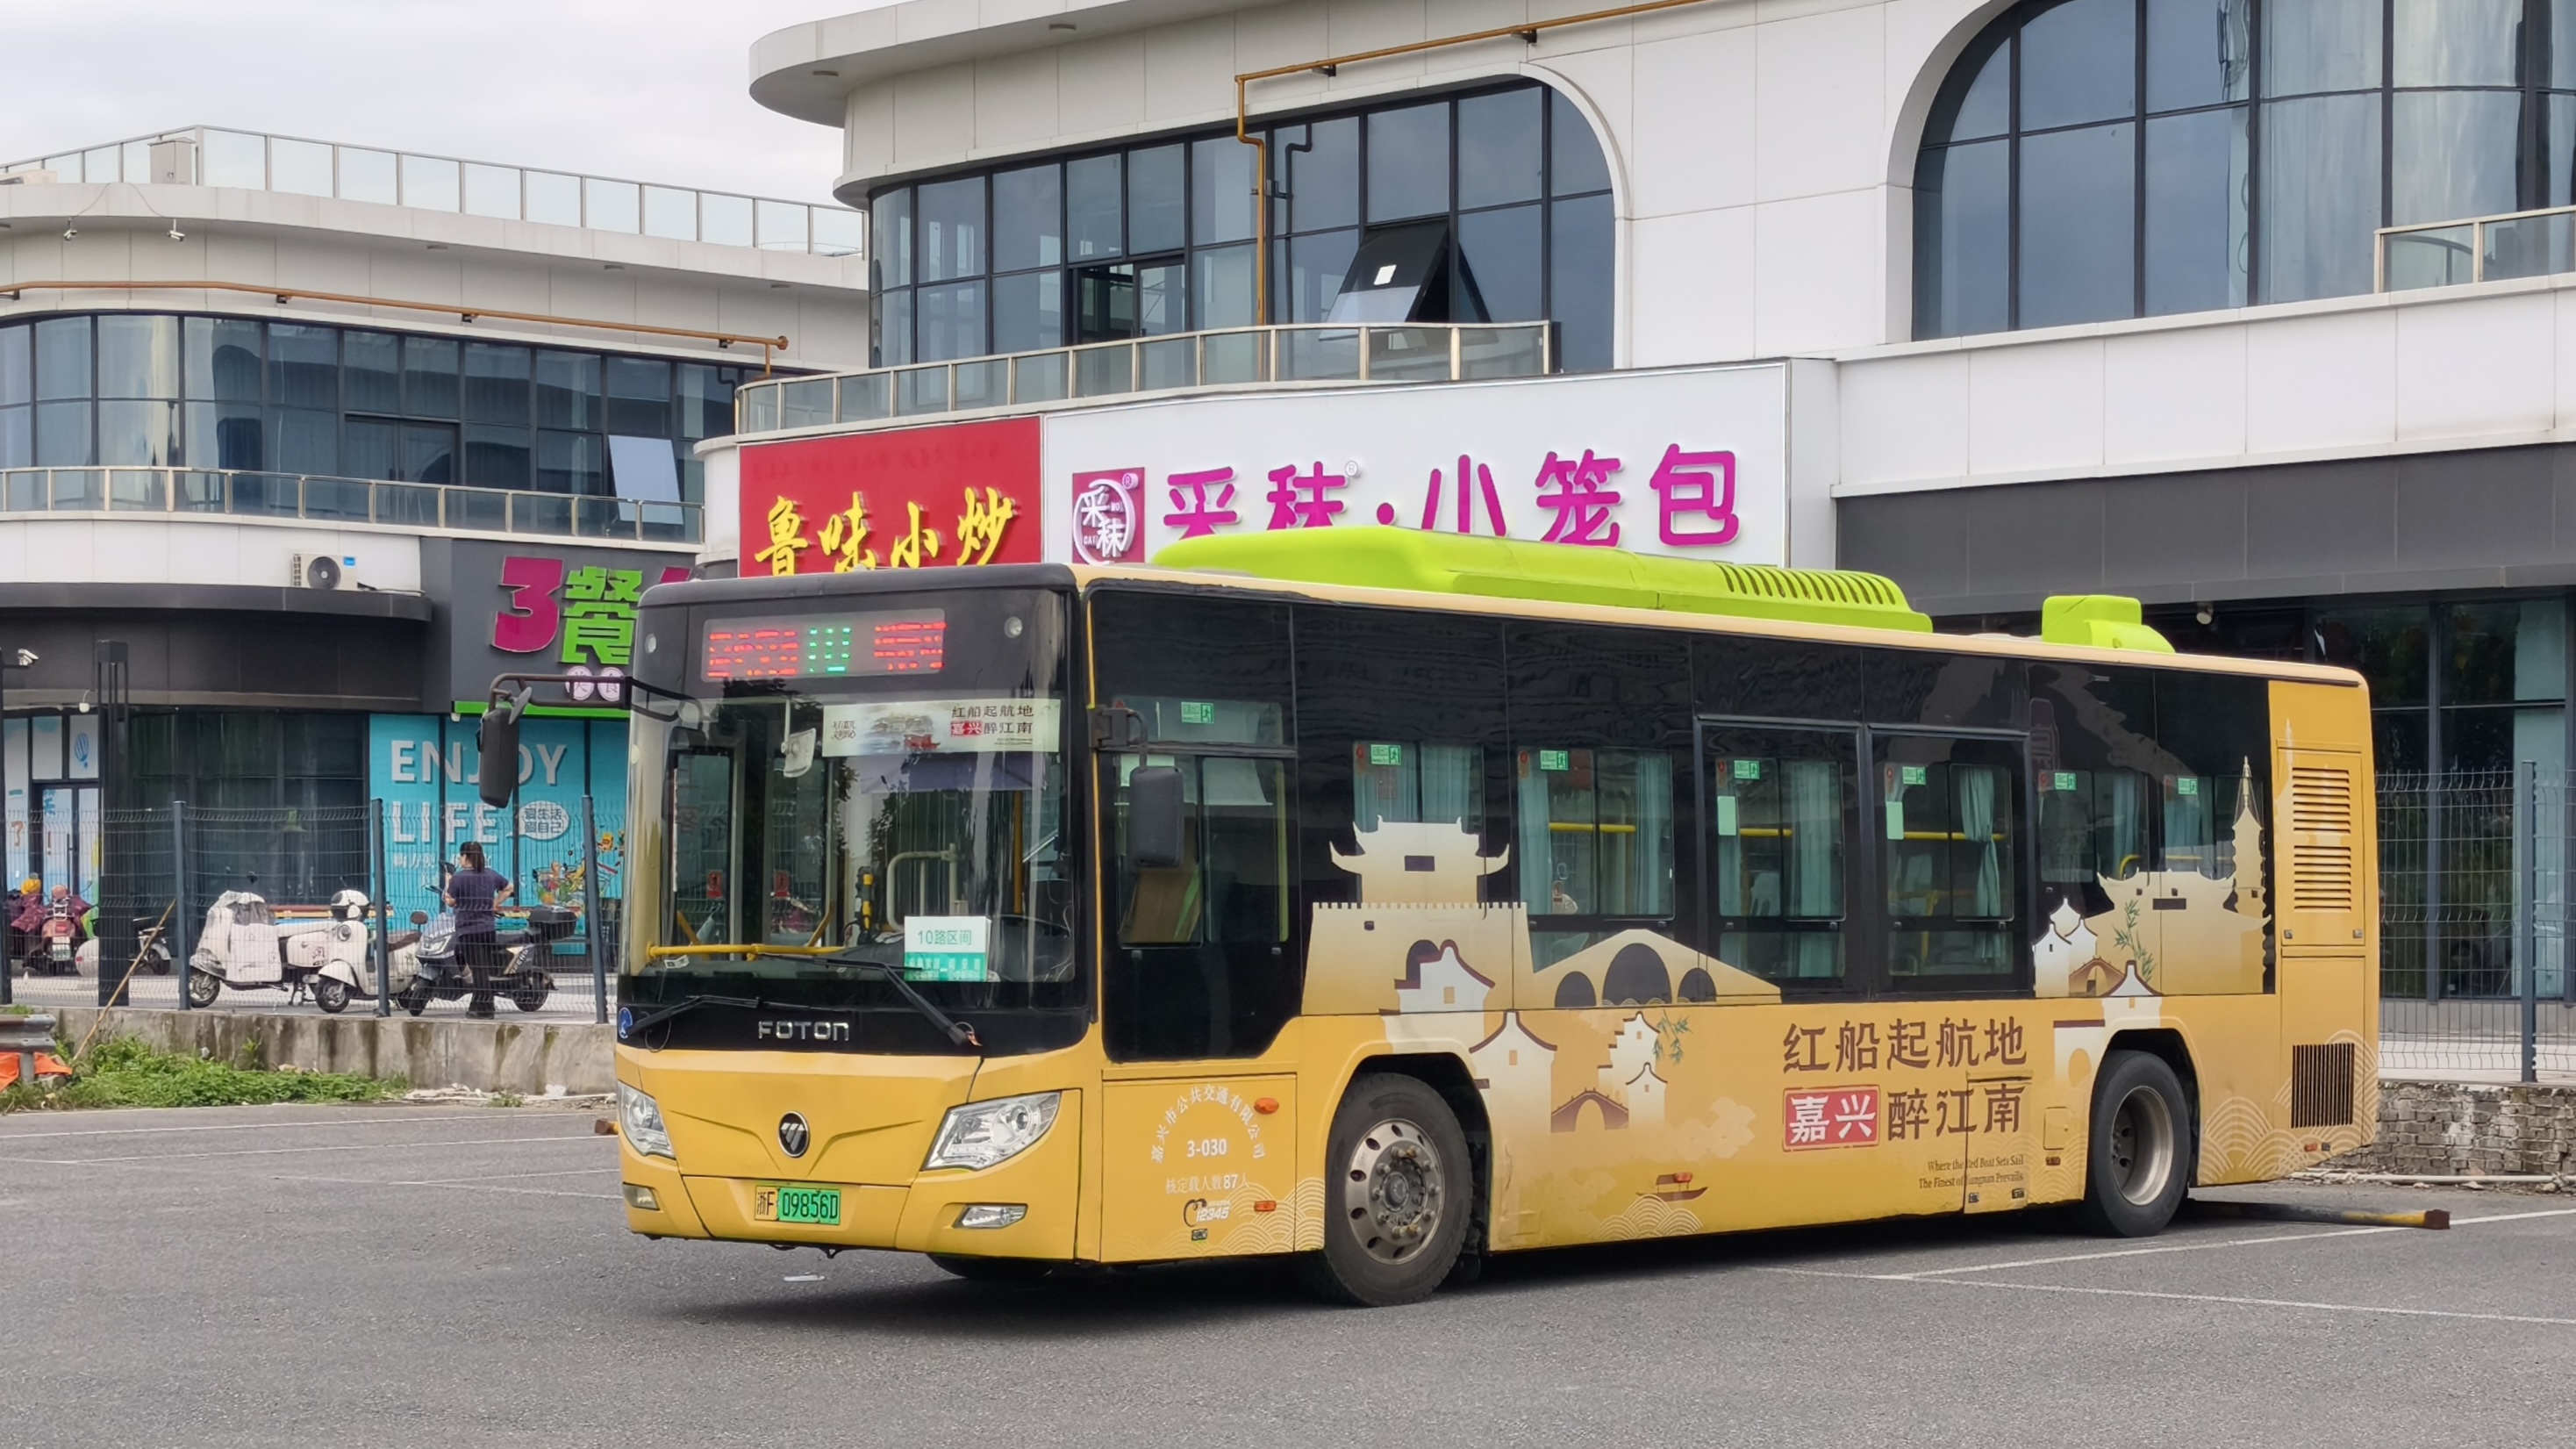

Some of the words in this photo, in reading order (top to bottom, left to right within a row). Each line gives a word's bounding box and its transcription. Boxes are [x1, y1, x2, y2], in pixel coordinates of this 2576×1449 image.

[755, 487, 1013, 576] 鲁味小炒
[952, 706, 1034, 718] 红船起航地
[984, 722, 1034, 735] 醉江南
[392, 801, 498, 843] LIFE
[918, 929, 972, 945] 10路区间
[758, 1021, 849, 1041] FOTON
[1783, 1016, 2027, 1073] 红船起航地
[1151, 1084, 1265, 1163] 嘉兴市公共交通有限公司
[1789, 1094, 1876, 1144] 嘉兴
[1887, 1083, 2025, 1141] 醉江南
[1187, 1138, 1227, 1158] 3-030
[1928, 1160, 1951, 1171] Where
[1919, 1178, 1932, 1188] The
[1196, 1206, 1229, 1222] 12345
